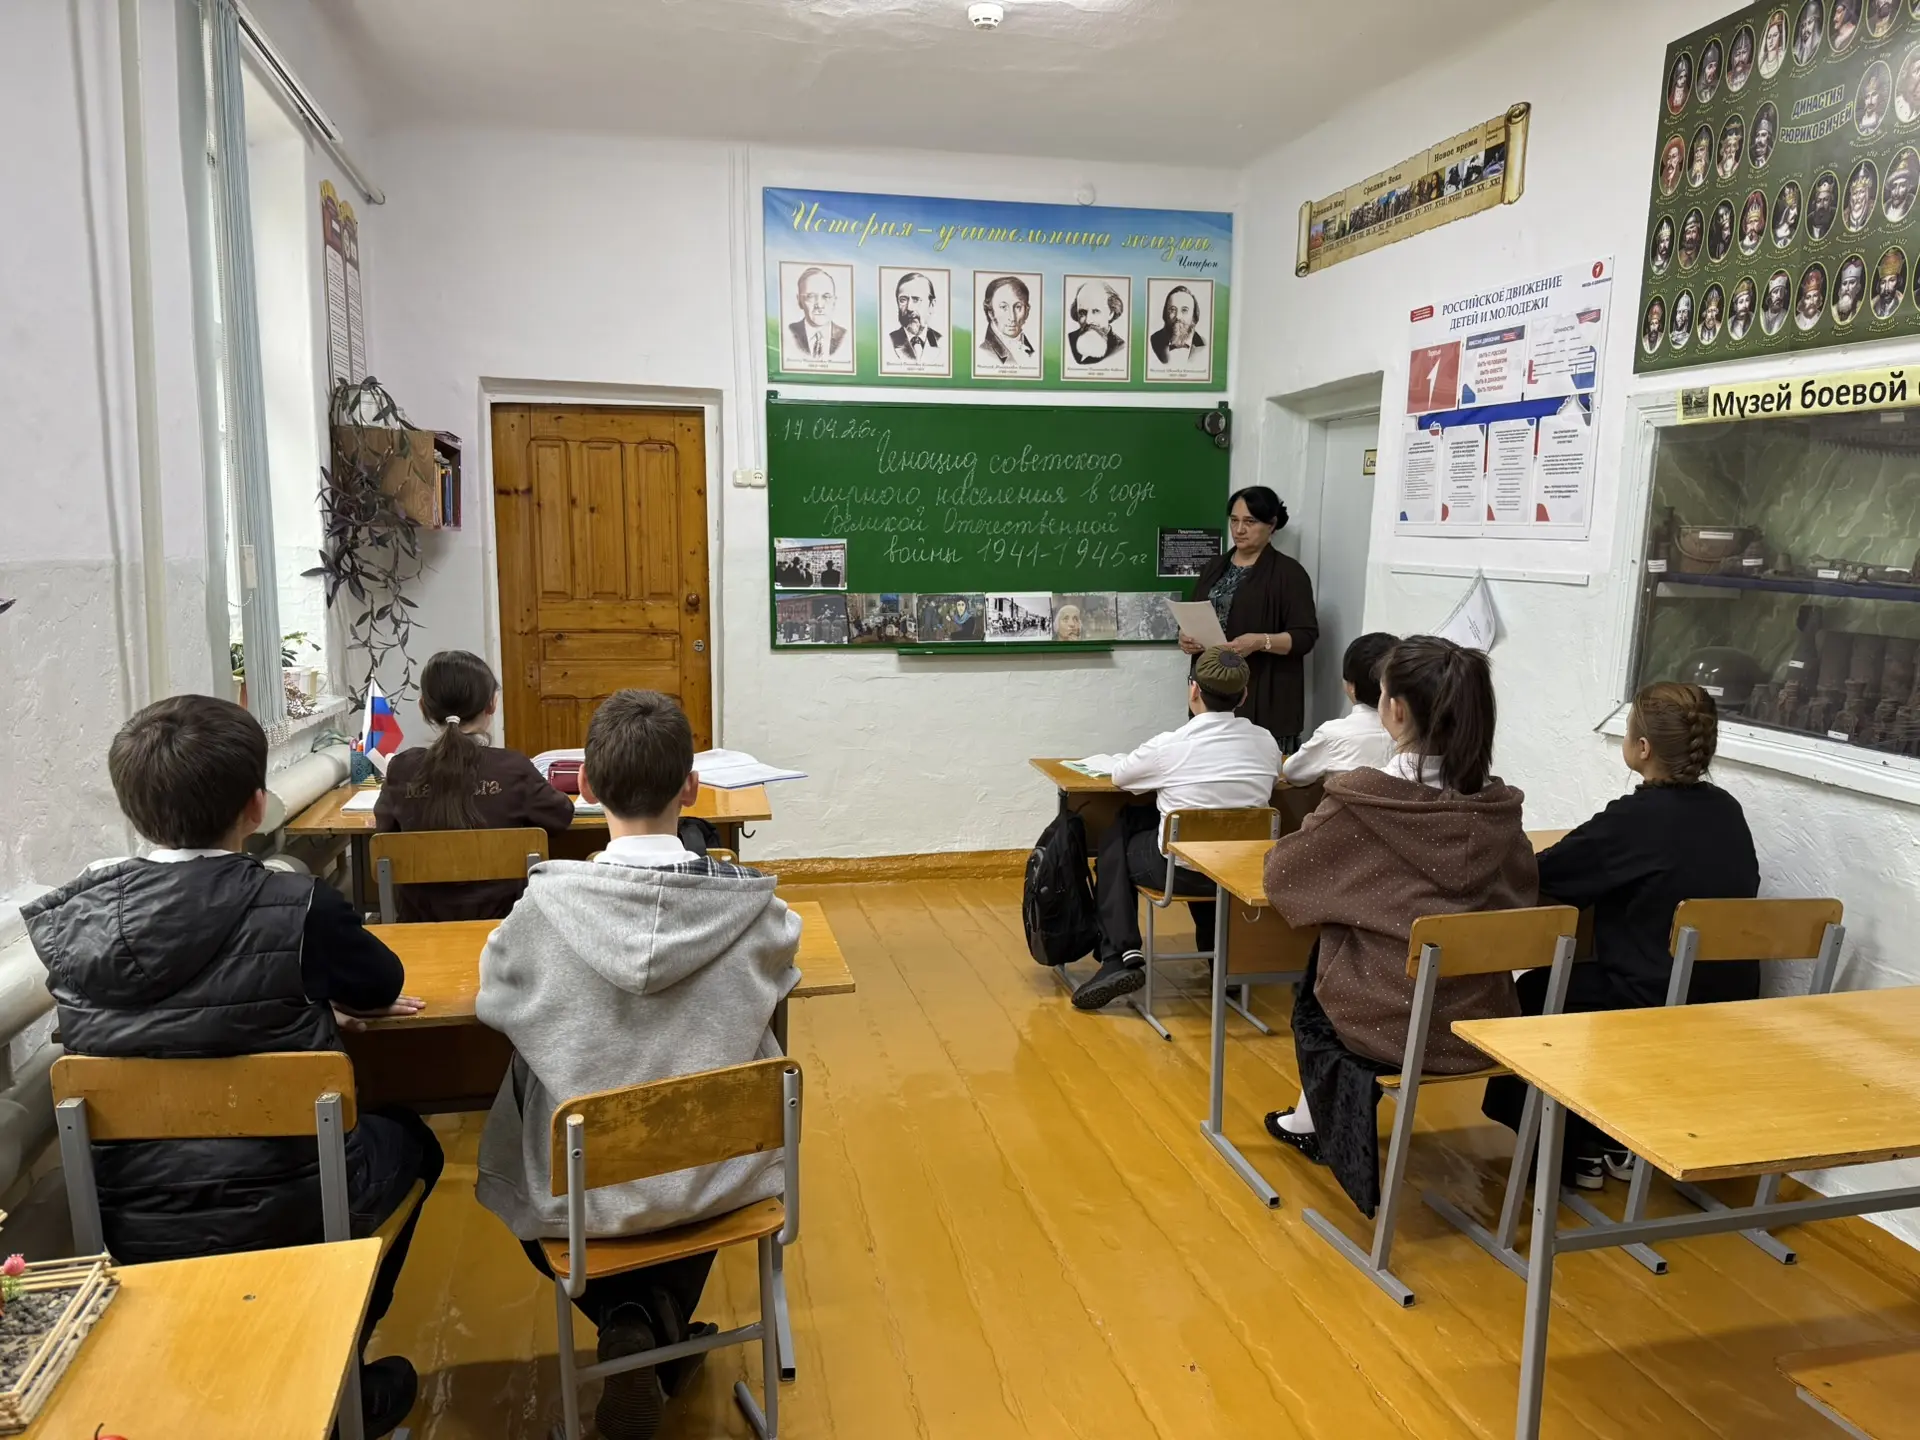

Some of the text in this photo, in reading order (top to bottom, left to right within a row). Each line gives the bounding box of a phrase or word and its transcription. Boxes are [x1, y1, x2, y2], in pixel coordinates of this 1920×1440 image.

[1791, 84, 1845, 120] ДИНАСТИЯ
[1779, 101, 1854, 144] РЮРИКОВИЧЕЙ
[1434, 137, 1478, 163] Новое время
[1476, 182, 1485, 192] XX
[1489, 177, 1501, 187] XXI
[791, 200, 913, 247] История
[1442, 287, 1505, 316] РОССИЙСКОЕ
[1505, 275, 1563, 301] ДВИЖЕНИЕ
[1449, 311, 1478, 331] ДЕТЕЙ
[1481, 309, 1488, 322] И
[1489, 296, 1549, 321] МОЛОДЕЖИ
[1713, 382, 1792, 418] Музей
[1800, 370, 1907, 409] боевой
[877, 429, 1123, 488] Геноцид советского
[803, 485, 921, 519] мирного
[935, 486, 1070, 506] населения
[1080, 472, 1104, 504] в
[821, 504, 1119, 537] Великой Отечественной
[883, 534, 964, 563] войны
